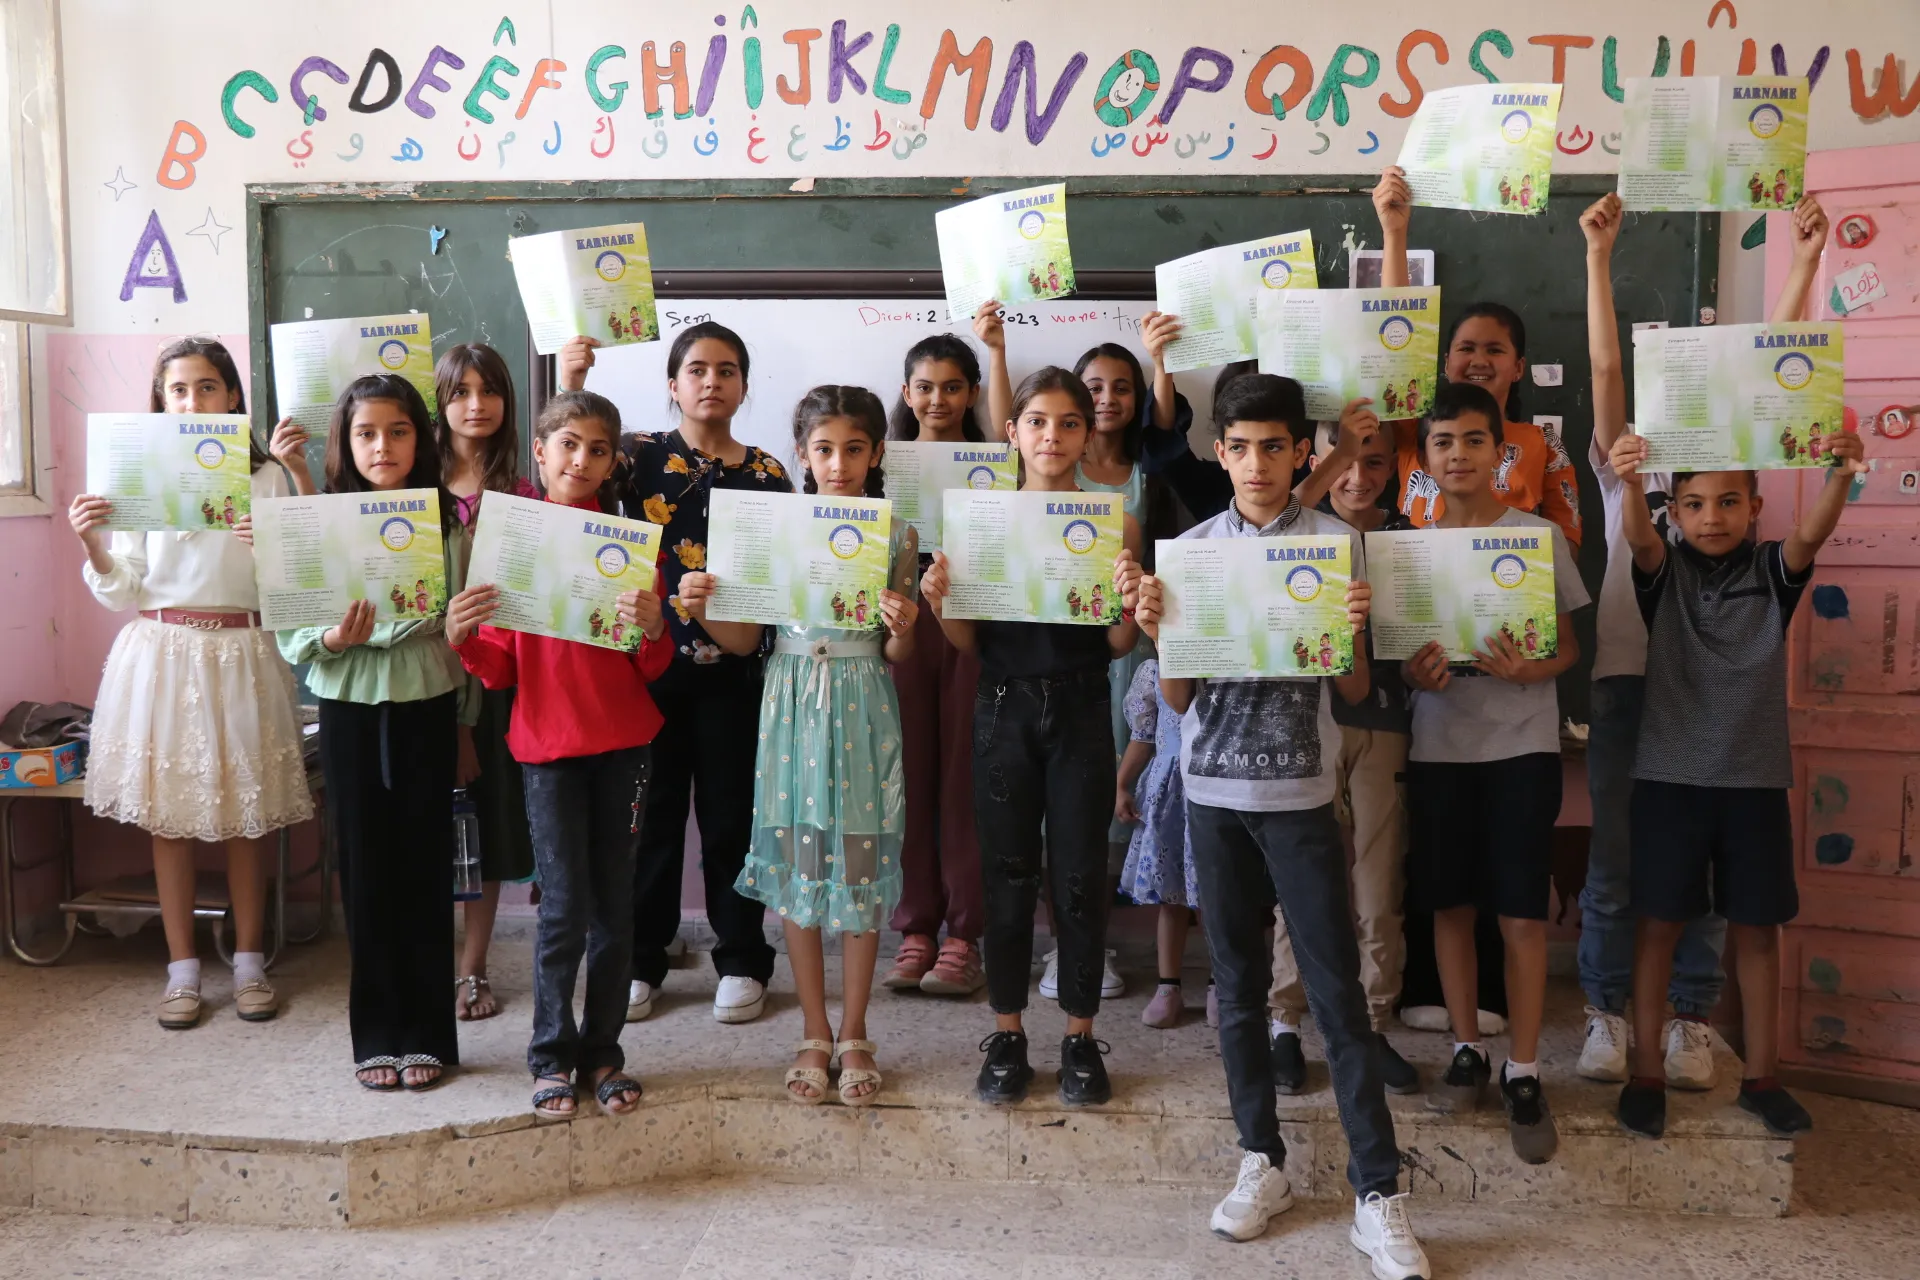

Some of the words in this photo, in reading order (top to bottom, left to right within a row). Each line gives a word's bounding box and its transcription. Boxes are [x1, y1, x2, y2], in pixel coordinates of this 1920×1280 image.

[1492, 94, 1549, 107] KARNAME
[1733, 87, 1797, 100] KARNAME
[457, 120, 482, 161] ن
[543, 121, 561, 155] ل
[642, 118, 675, 159] ق
[694, 118, 719, 156] ف
[747, 114, 769, 163] غ
[824, 116, 851, 151] ظ
[864, 109, 891, 150] ط
[1210, 122, 1234, 160] ز
[1309, 122, 1330, 155] ذ
[286, 130, 314, 168] ي
[336, 132, 365, 162] و
[497, 131, 516, 168] م
[787, 125, 808, 162] ع
[1092, 132, 1124, 157] ص
[1175, 130, 1210, 158] س
[1358, 131, 1379, 154] د
[120, 210, 187, 302] A
[157, 120, 206, 190] B
[222, 70, 278, 138] C
[348, 48, 402, 113] D
[405, 45, 464, 118] E
[464, 16, 518, 123] Ê
[515, 59, 567, 119] F
[585, 45, 628, 112] G
[642, 41, 693, 118] H
[776, 29, 821, 106] J
[828, 19, 873, 102] K
[872, 24, 910, 103] L
[920, 29, 992, 130] M
[991, 40, 1086, 145] N
[1094, 49, 1159, 126] O
[1159, 47, 1233, 124] P
[1245, 45, 1314, 120] Q
[1307, 44, 1380, 126] R
[1379, 30, 1449, 118] S
[1528, 35, 1594, 112] T
[1003, 193, 1055, 213] KARNAME
[576, 234, 635, 250] KARNAME
[1243, 241, 1302, 262] KARNAME
[1843, 269, 1881, 300] 2019
[1361, 298, 1428, 312] KARNAME
[360, 324, 418, 338] KARNAME
[1754, 333, 1829, 349] KARNAME
[179, 423, 239, 435] KARNAME
[954, 451, 1008, 462] KARNAME
[360, 500, 427, 515] KARNAME
[813, 506, 879, 521] KARNAME
[1046, 503, 1111, 515] KARNAME
[583, 521, 649, 546] KARNAME
[1472, 537, 1539, 551] KARNAME
[1266, 547, 1337, 561] KARNAME
[1203, 751, 1307, 767] FAMOUS
